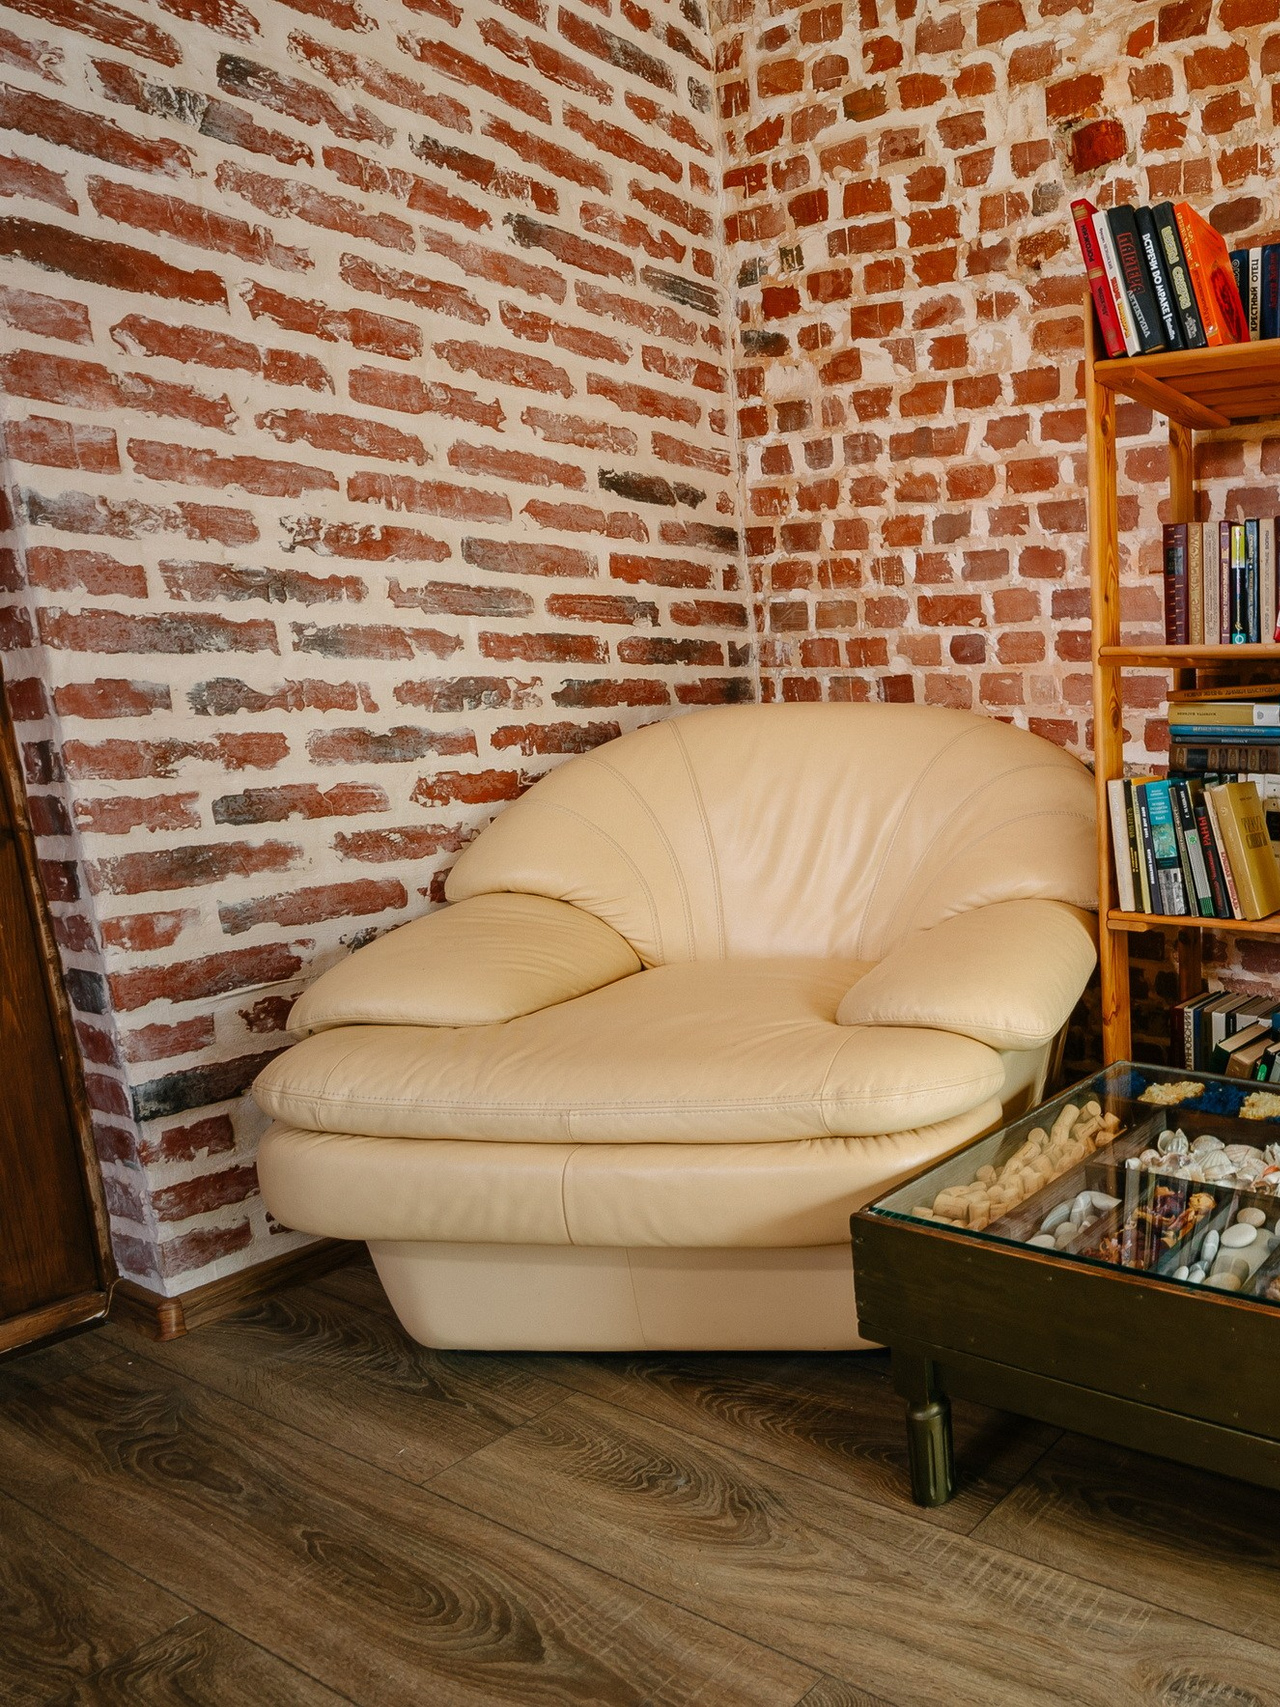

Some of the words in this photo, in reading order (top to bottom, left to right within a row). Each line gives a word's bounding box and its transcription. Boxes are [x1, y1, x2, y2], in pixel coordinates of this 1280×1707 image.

[1142, 233, 1159, 270] ВСТРЕЧИ
[1152, 270, 1163, 284] ВО
[1251, 259, 1259, 282] ОТЕЦ
[1155, 284, 1171, 315] МРАКЕ
[1250, 286, 1258, 332] КРЕСТНЫЙ
[1198, 816, 1211, 847] РАНЫ
